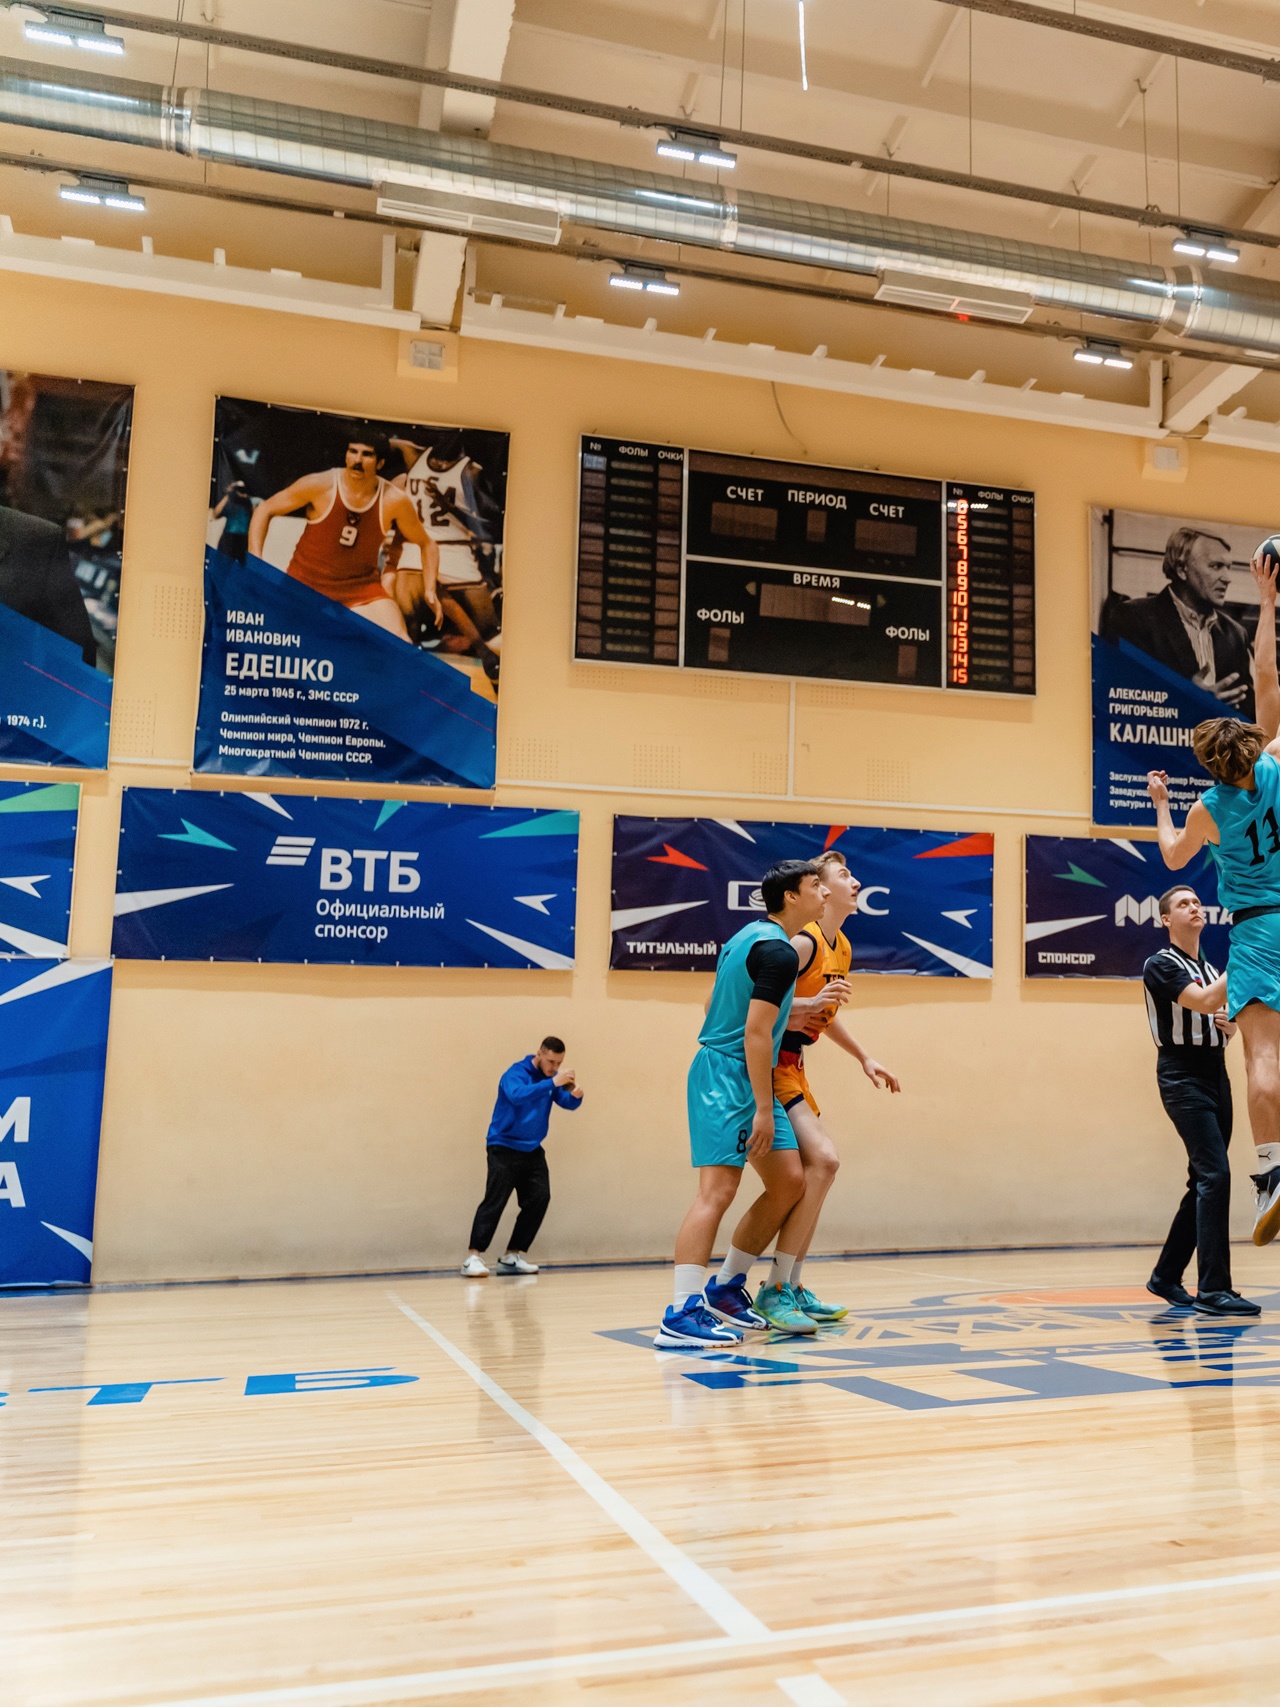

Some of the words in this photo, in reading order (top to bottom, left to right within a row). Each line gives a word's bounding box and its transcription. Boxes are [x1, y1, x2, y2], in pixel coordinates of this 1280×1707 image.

[619, 446, 649, 457] ФОЛЫ
[658, 450, 684, 461] ОЧКИ
[726, 485, 765, 502] СЧЕТ
[787, 489, 848, 511] ПЕРИОД
[978, 490, 1004, 501] ФОЛЫ
[869, 502, 906, 519] СЧЕТ
[957, 514, 968, 530] 5
[339, 525, 358, 547] 9
[957, 530, 968, 545] 6
[958, 545, 968, 560] 7
[957, 560, 968, 576] 8
[793, 572, 841, 589] ВРЕМЯ
[957, 575, 968, 591] 9
[953, 590, 968, 606] 10
[227, 610, 264, 626] ИВАН
[696, 608, 744, 625] ФОЛЫ
[953, 606, 968, 621] 11
[885, 625, 930, 641] ФОЛЫ
[953, 621, 968, 637] 12
[226, 629, 301, 647] ИВАНОВИЧ
[953, 637, 968, 652] 13
[225, 652, 334, 682] ЕДЕШКО
[953, 653, 968, 668] 14
[953, 668, 968, 684] 15
[224, 685, 236, 696] 25
[238, 687, 269, 698] марта
[272, 688, 294, 698] 1945
[308, 690, 331, 701] ЗМС
[333, 692, 359, 703] СССР
[1109, 687, 1168, 703] АЛЕКСАНДР
[1109, 703, 1178, 719] ГРИГОРЬЕВИЧ
[7, 714, 30, 727] 1974
[221, 711, 291, 725] Олимпийский
[293, 717, 337, 728] чемпион
[339, 718, 360, 730] 1972
[362, 721, 369, 730] г.
[220, 728, 264, 741] Чемпион
[267, 732, 295, 743] мира,
[298, 732, 343, 745] Чемпион
[345, 735, 386, 748] Европы.
[1109, 722, 1195, 748] КАЛАШН
[219, 745, 295, 759] Многократный
[298, 749, 343, 762] Чемпион
[345, 752, 373, 764] СССР.
[1109, 771, 1148, 783] Заслужен
[1166, 777, 1188, 786] ренер
[1109, 785, 1149, 798] Заведующ
[1168, 790, 1196, 800] федрой
[319, 848, 421, 893] ВТБ
[315, 898, 445, 921] Официальный
[315, 922, 389, 942] спонсор
[627, 941, 717, 956] ТИТУЛЬНЫЙ
[1038, 951, 1096, 965] СПОНСОР
[736, 1129, 748, 1154] 8
